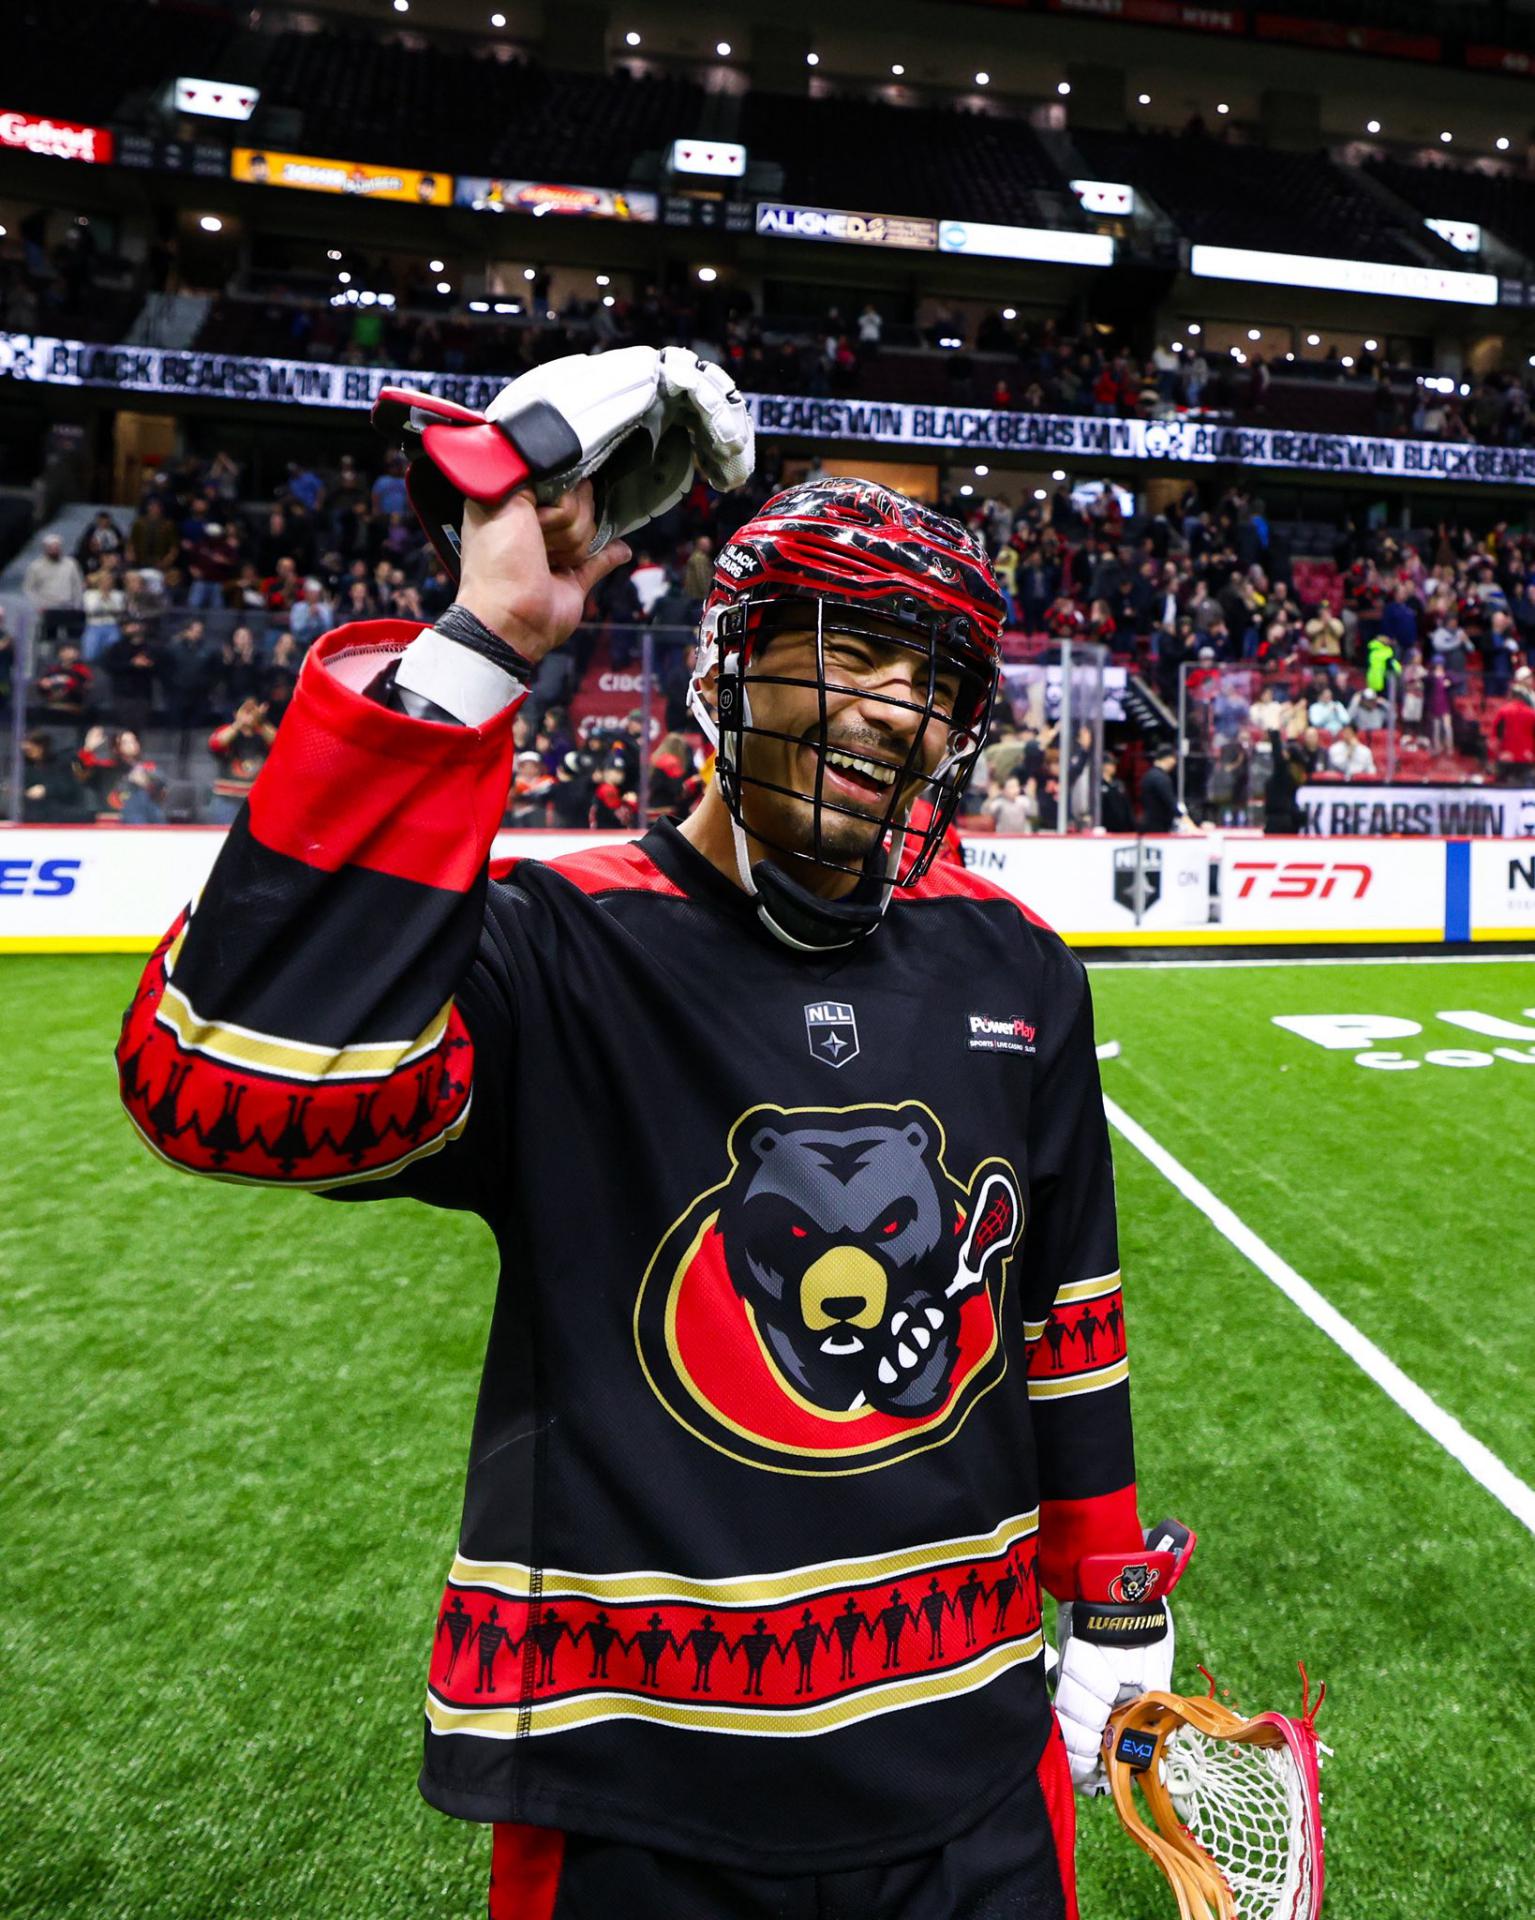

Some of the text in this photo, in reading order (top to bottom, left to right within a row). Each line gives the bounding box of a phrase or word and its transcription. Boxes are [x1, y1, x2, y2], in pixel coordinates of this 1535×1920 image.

[759, 400, 842, 434] BEARS
[844, 406, 902, 436] WIN
[914, 411, 992, 443] BLACK
[995, 415, 1075, 447] BEARS
[1195, 429, 1266, 459] BLACK
[1271, 434, 1344, 466] BEARS
[1403, 444, 1473, 474] BLACK
[718, 553, 743, 578] BEARS
[727, 544, 758, 572] BLACK
[1331, 803, 1434, 836] BEARS
[1439, 804, 1504, 836] WIN
[1233, 862, 1373, 899] TSN
[808, 1005, 850, 1022] NLL
[969, 1016, 1036, 1043] PowerPlay
[1122, 1738, 1154, 1759] EVO
